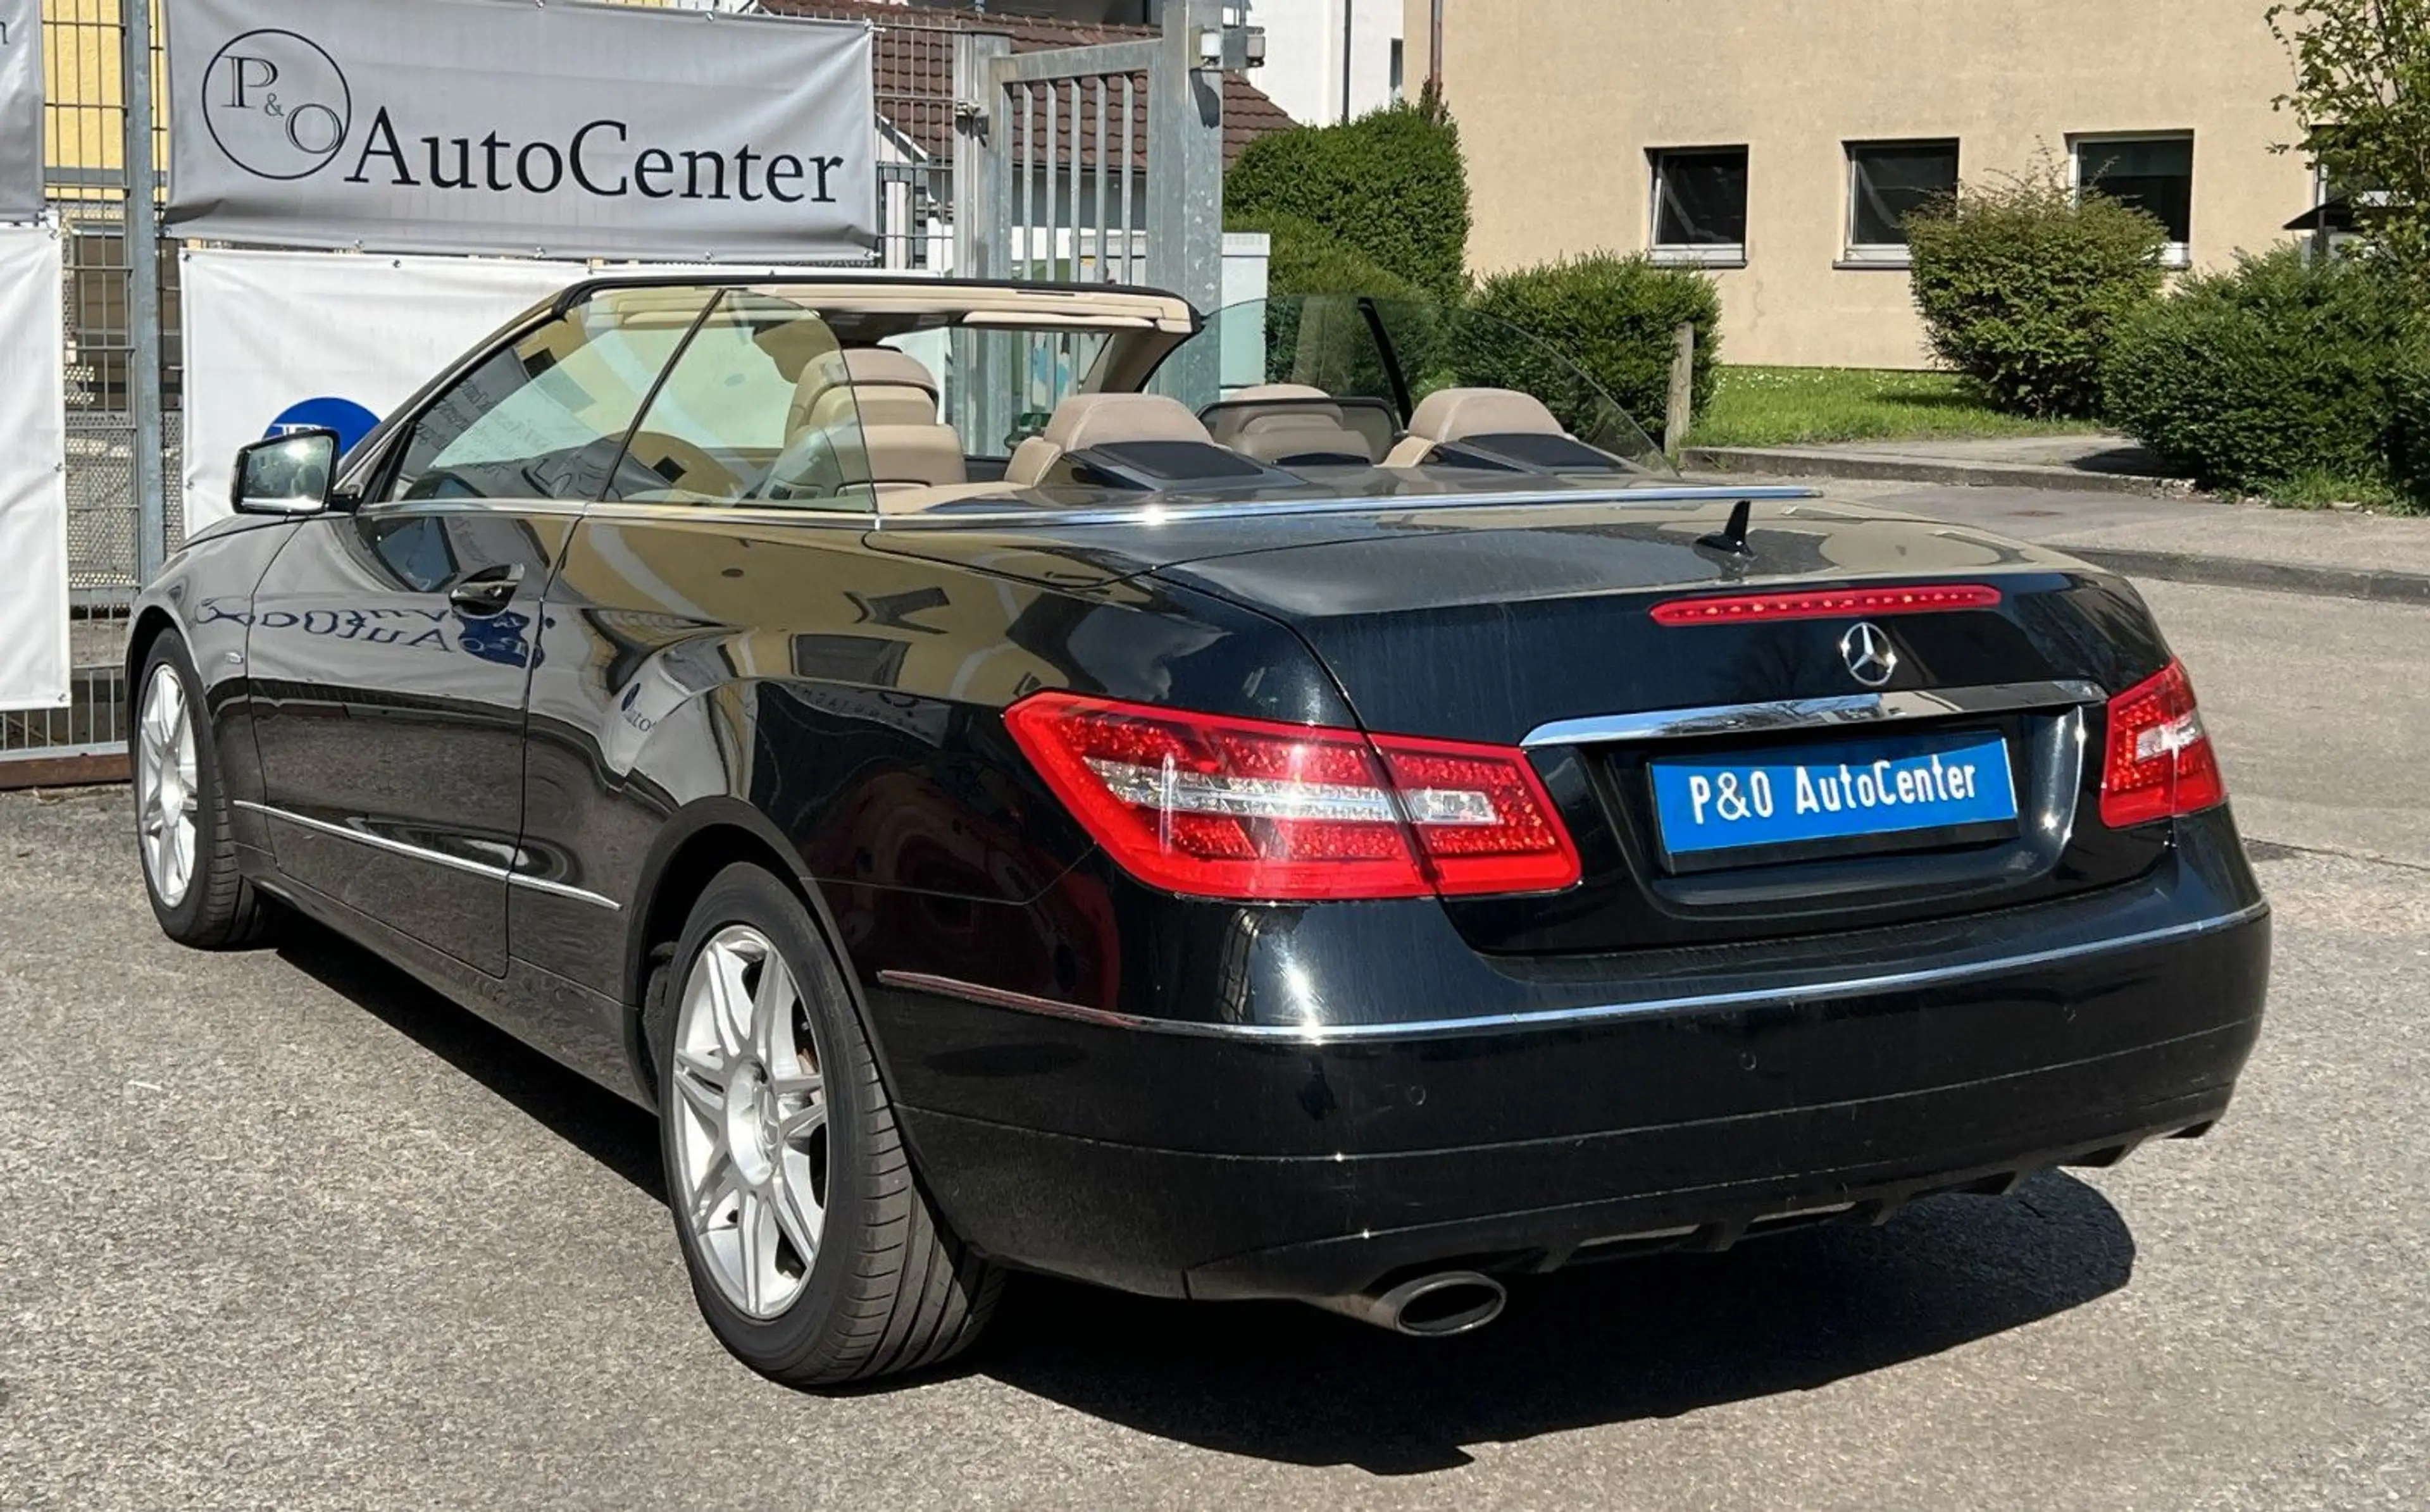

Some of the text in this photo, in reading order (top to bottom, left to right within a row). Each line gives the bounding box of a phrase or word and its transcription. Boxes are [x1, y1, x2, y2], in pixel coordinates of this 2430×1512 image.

[344, 105, 844, 202] AutoCenter
[1689, 753, 1976, 824] P&O AutoCenter
